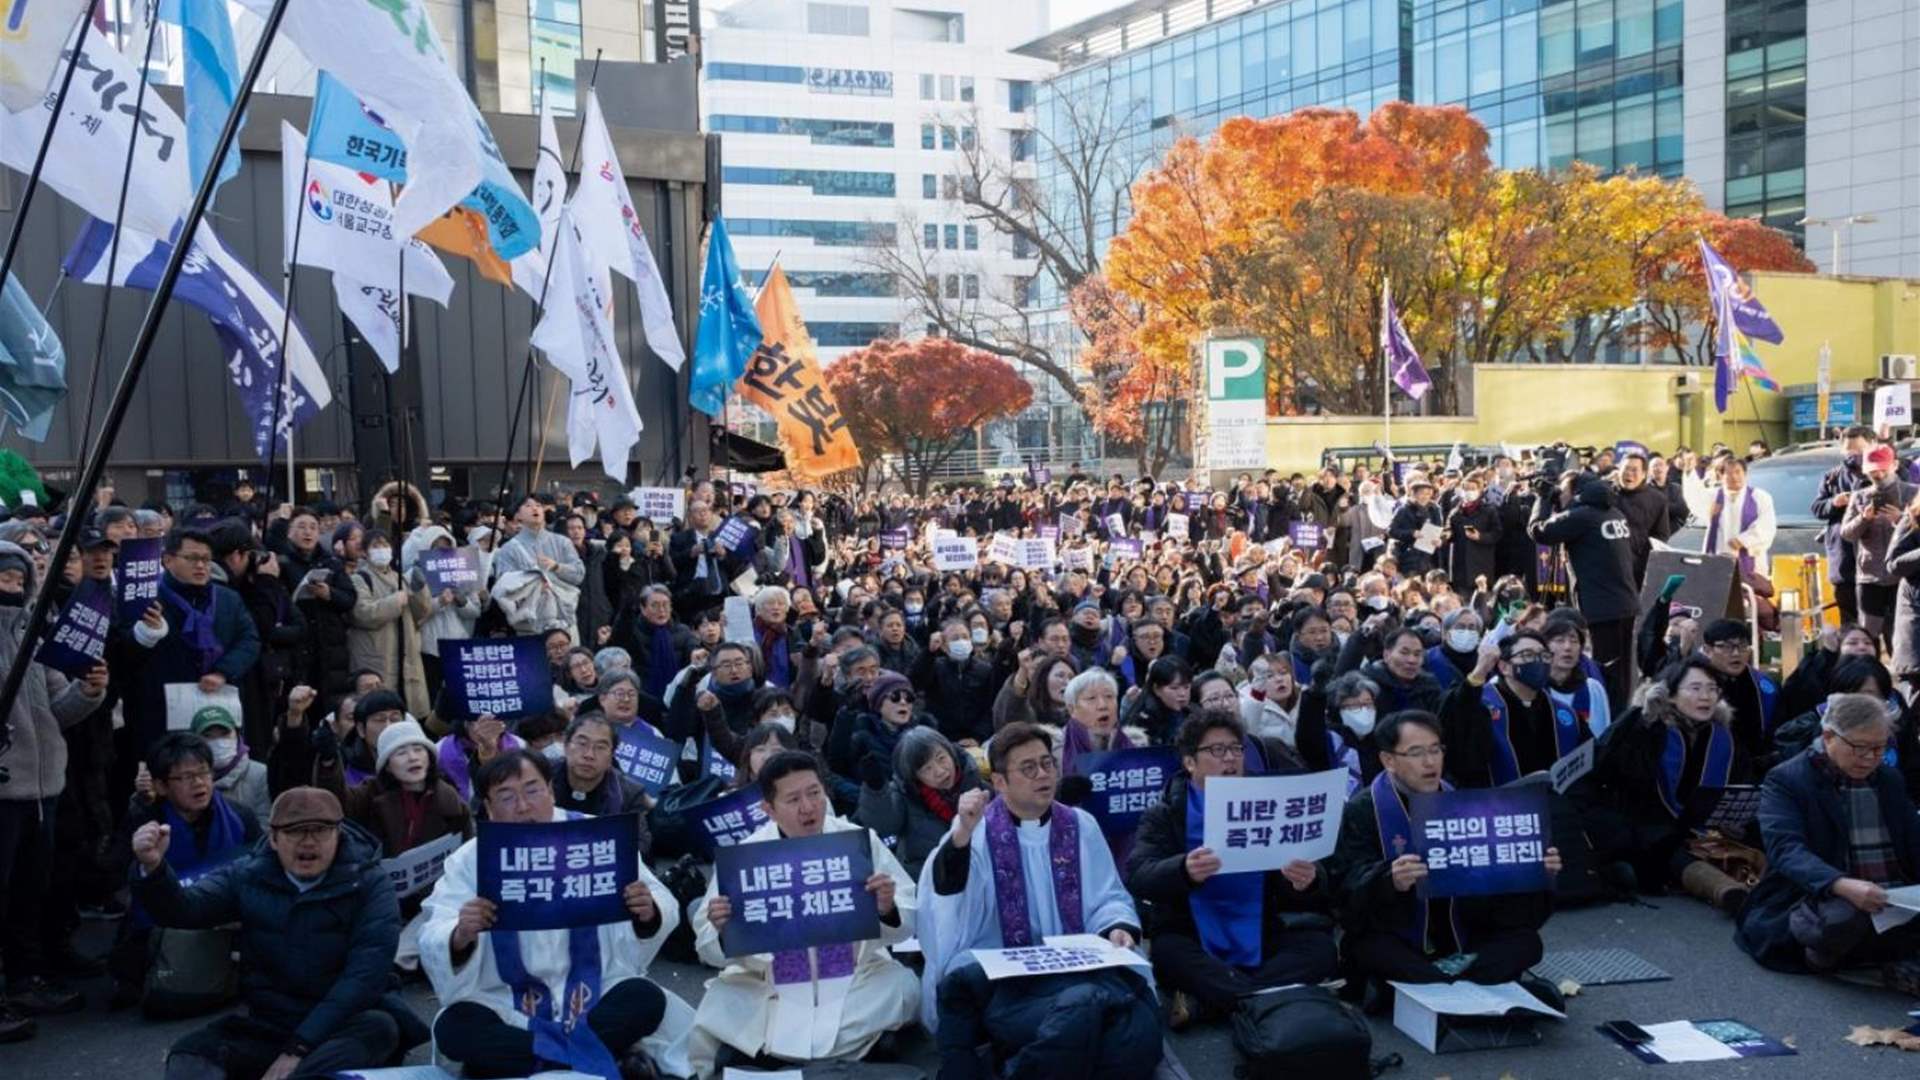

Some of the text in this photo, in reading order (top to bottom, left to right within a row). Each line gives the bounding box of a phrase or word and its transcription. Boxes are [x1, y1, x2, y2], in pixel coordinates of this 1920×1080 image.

[1209, 340, 1261, 398] P
[744, 341, 849, 456] 한빛
[1601, 519, 1631, 540] CBS
[460, 644, 514, 661] 노동탄압
[462, 662, 517, 679] 규탄한다
[466, 680, 520, 697] 윤석열은
[468, 697, 522, 714] 퇴진하라
[632, 764, 664, 784] 퇴진!
[639, 749, 670, 774] 명령!
[1090, 766, 1163, 792] 윤석열은
[1227, 792, 1328, 822] 내란 공범
[702, 810, 746, 833] 내란
[1226, 820, 1324, 848] 즉각 체포
[1424, 813, 1541, 841] 국민의 명령!
[500, 839, 616, 872] 내란 공범
[1426, 840, 1544, 870] 윤석열 퇴진!
[500, 871, 617, 903] 즉각 체포
[740, 855, 851, 893] 내란 공범
[743, 887, 856, 924] 즉각 체포
